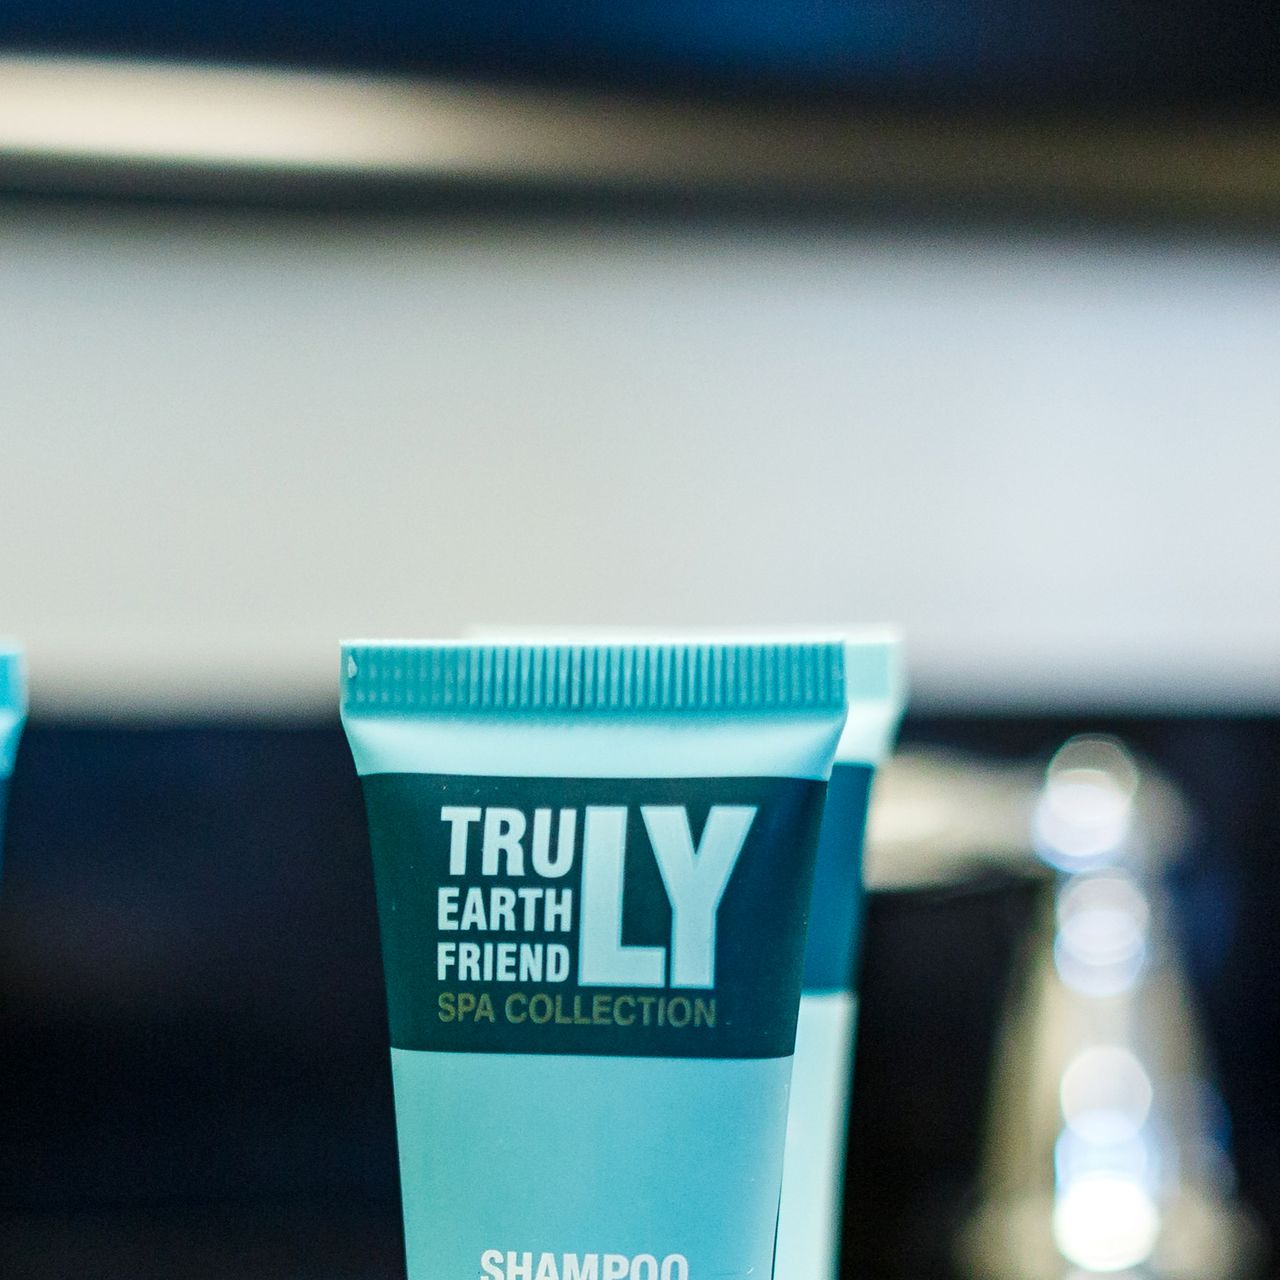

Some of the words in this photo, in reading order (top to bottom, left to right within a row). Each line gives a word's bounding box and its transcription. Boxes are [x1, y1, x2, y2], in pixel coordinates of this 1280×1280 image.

[440, 807, 577, 879] TRU
[437, 886, 572, 933] EARTH
[437, 943, 570, 983] FRIEND
[437, 992, 496, 1023] SPA
[504, 993, 717, 1029] COLLECTION
